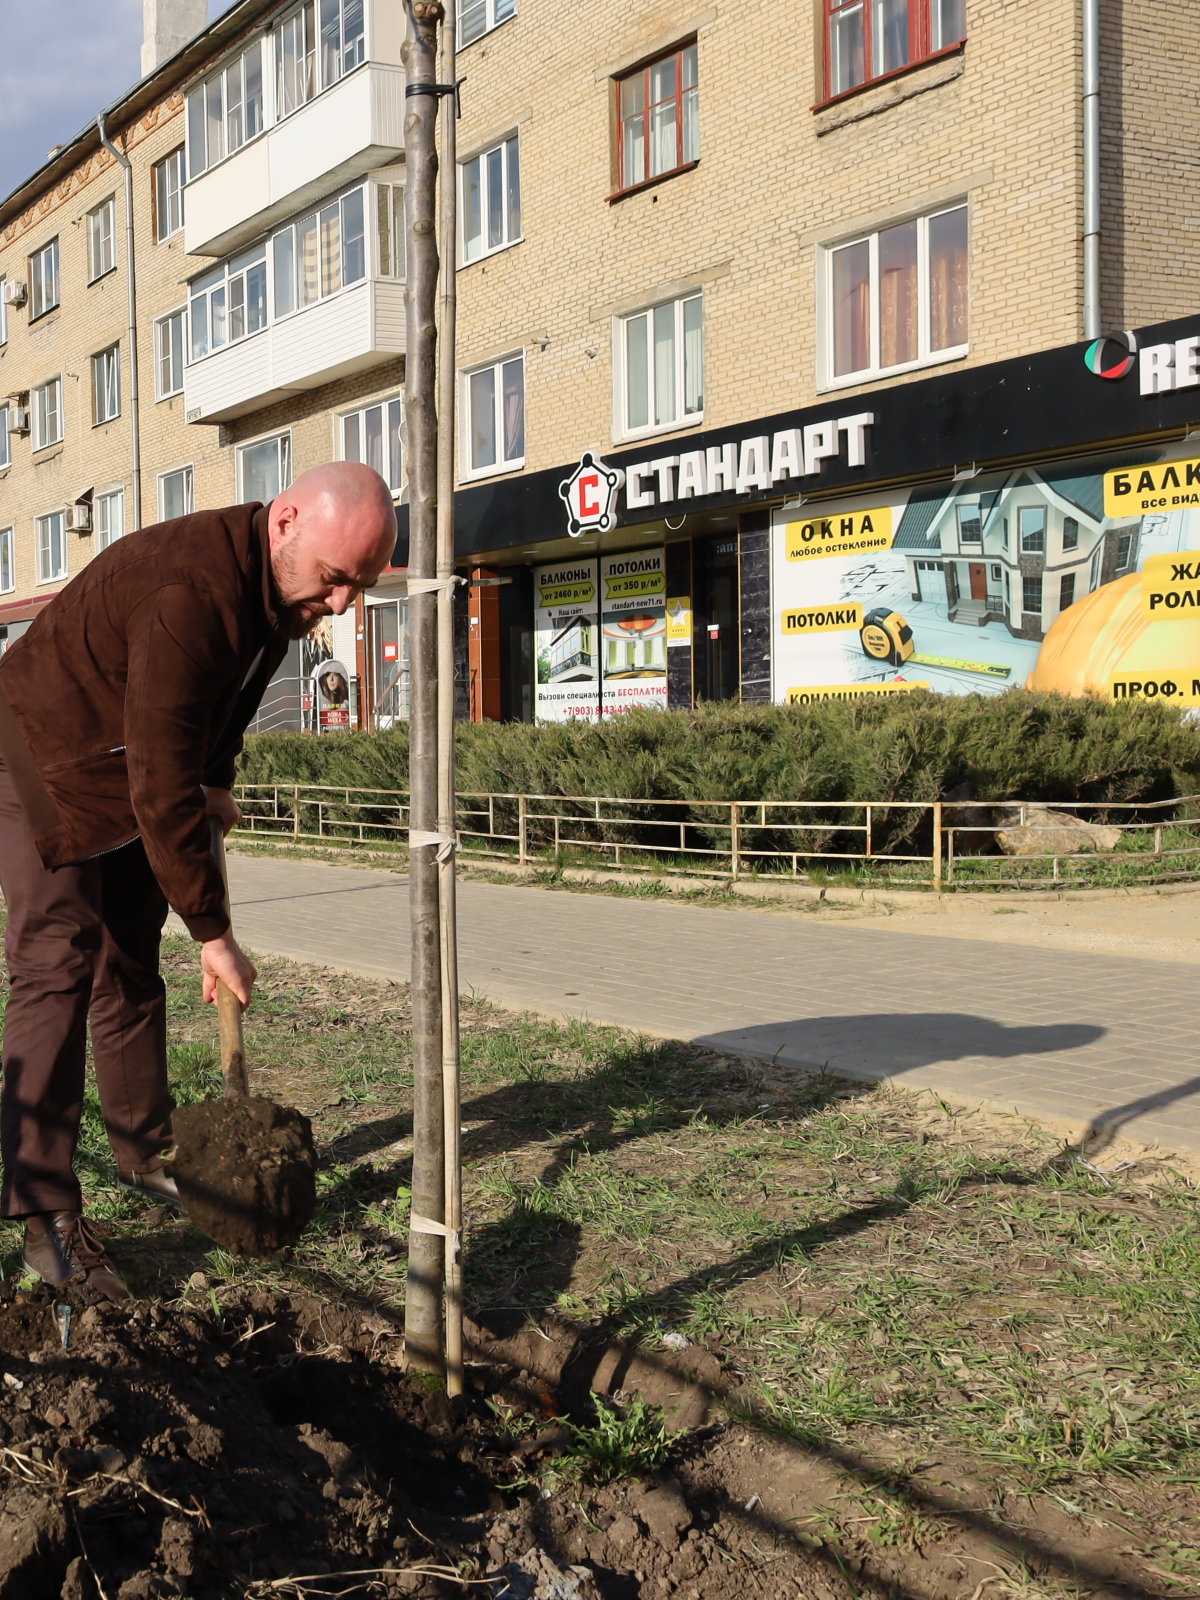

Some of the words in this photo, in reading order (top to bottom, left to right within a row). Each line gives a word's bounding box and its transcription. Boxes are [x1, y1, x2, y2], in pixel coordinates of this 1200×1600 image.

[626, 412, 874, 510] СТАНДАРТ
[1141, 496, 1167, 509] все
[801, 514, 874, 542] ОКНА
[790, 546, 822, 558] любое
[825, 537, 887, 553] остекление
[609, 557, 661, 576] ПОТОЛКИ
[540, 567, 591, 586] БАЛКОНЫ
[544, 593, 552, 601] от
[554, 589, 572, 599] 2460
[612, 584, 622, 592] от
[623, 580, 639, 591] 350
[611, 598, 663, 611] standart-new71.ru
[1150, 589, 1200, 611] РОЛ
[558, 608, 570, 616] Наш
[570, 607, 584, 615] сайт:
[787, 609, 857, 629] ПОТОЛКИ
[538, 692, 566, 701] Вызови
[618, 686, 668, 697] БЕСПЛАТНО
[1113, 680, 1184, 698] ПРОФ.
[563, 706, 594, 717] +7(903)
